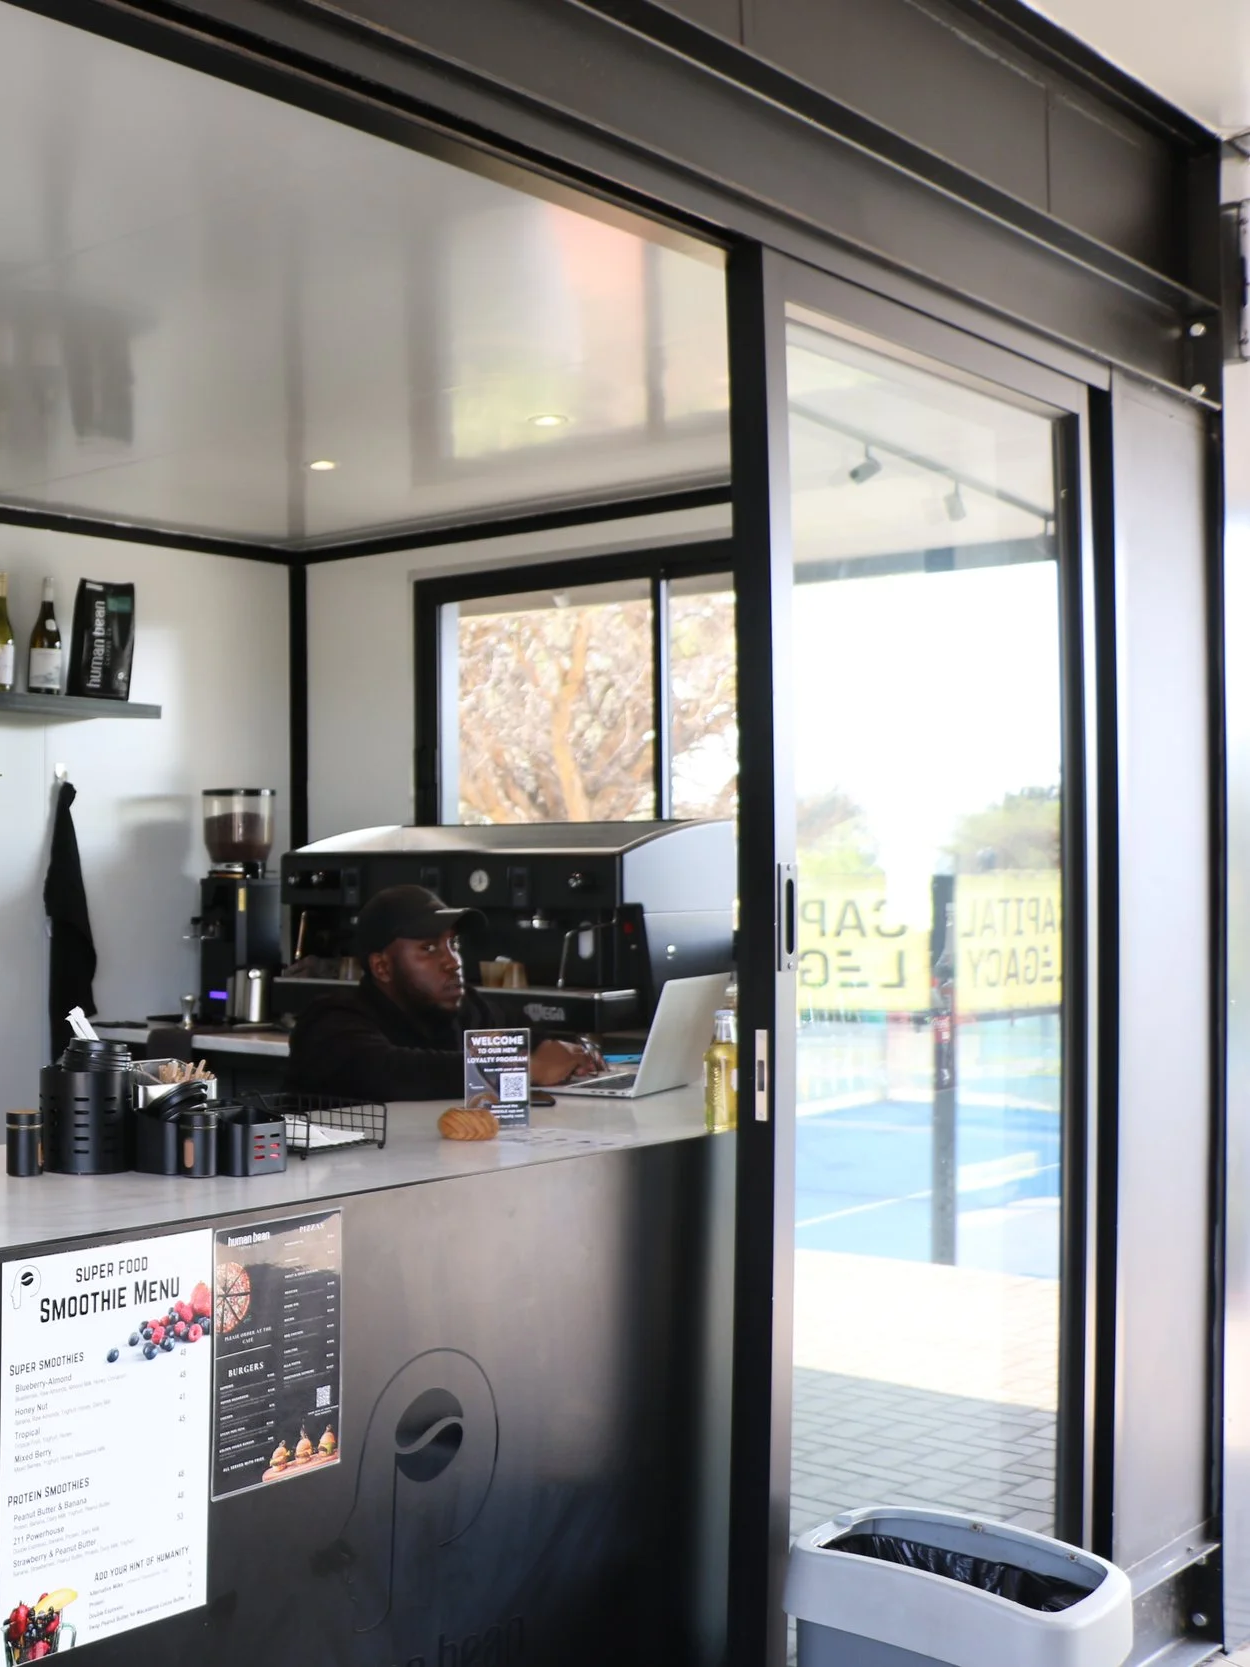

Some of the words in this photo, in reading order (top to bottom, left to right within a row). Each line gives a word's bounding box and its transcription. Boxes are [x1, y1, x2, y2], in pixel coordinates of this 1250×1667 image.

[91, 600, 106, 637] bean
[86, 638, 105, 689] human
[471, 1035, 524, 1047] WELCOME
[227, 1234, 252, 1247] human
[76, 1262, 114, 1283] SUPER
[119, 1256, 148, 1276] FOOD
[40, 1286, 127, 1323] SMOOTHIE
[134, 1276, 180, 1306] MENU
[9, 1359, 36, 1376] SUPER
[39, 1350, 84, 1370] SMOOTHIES
[228, 1361, 264, 1378] BURGERS
[15, 1373, 72, 1394] Blueberry-Almond
[14, 1405, 34, 1417] Honey
[36, 1401, 48, 1411] Nut
[14, 1426, 40, 1441] Tropical
[13, 1451, 33, 1463] Mixed
[34, 1447, 51, 1460] Berry
[7, 1488, 41, 1507] PROTEIN
[44, 1476, 89, 1498] SMOOTHIES
[13, 1509, 35, 1523] Peanut
[37, 1504, 56, 1516] Butter
[57, 1502, 62, 1511] &
[64, 1496, 87, 1509] Banana
[13, 1535, 23, 1545] 211
[25, 1524, 64, 1542] Powerhouse
[12, 1551, 47, 1569] Strawberry
[48, 1549, 53, 1558] &
[55, 1543, 76, 1557] Peanut
[77, 1537, 96, 1550] Butter
[110, 1563, 127, 1577] YOUR
[129, 1559, 143, 1571] HINT
[146, 1555, 154, 1566] OF
[156, 1544, 189, 1563] HUMANITY
